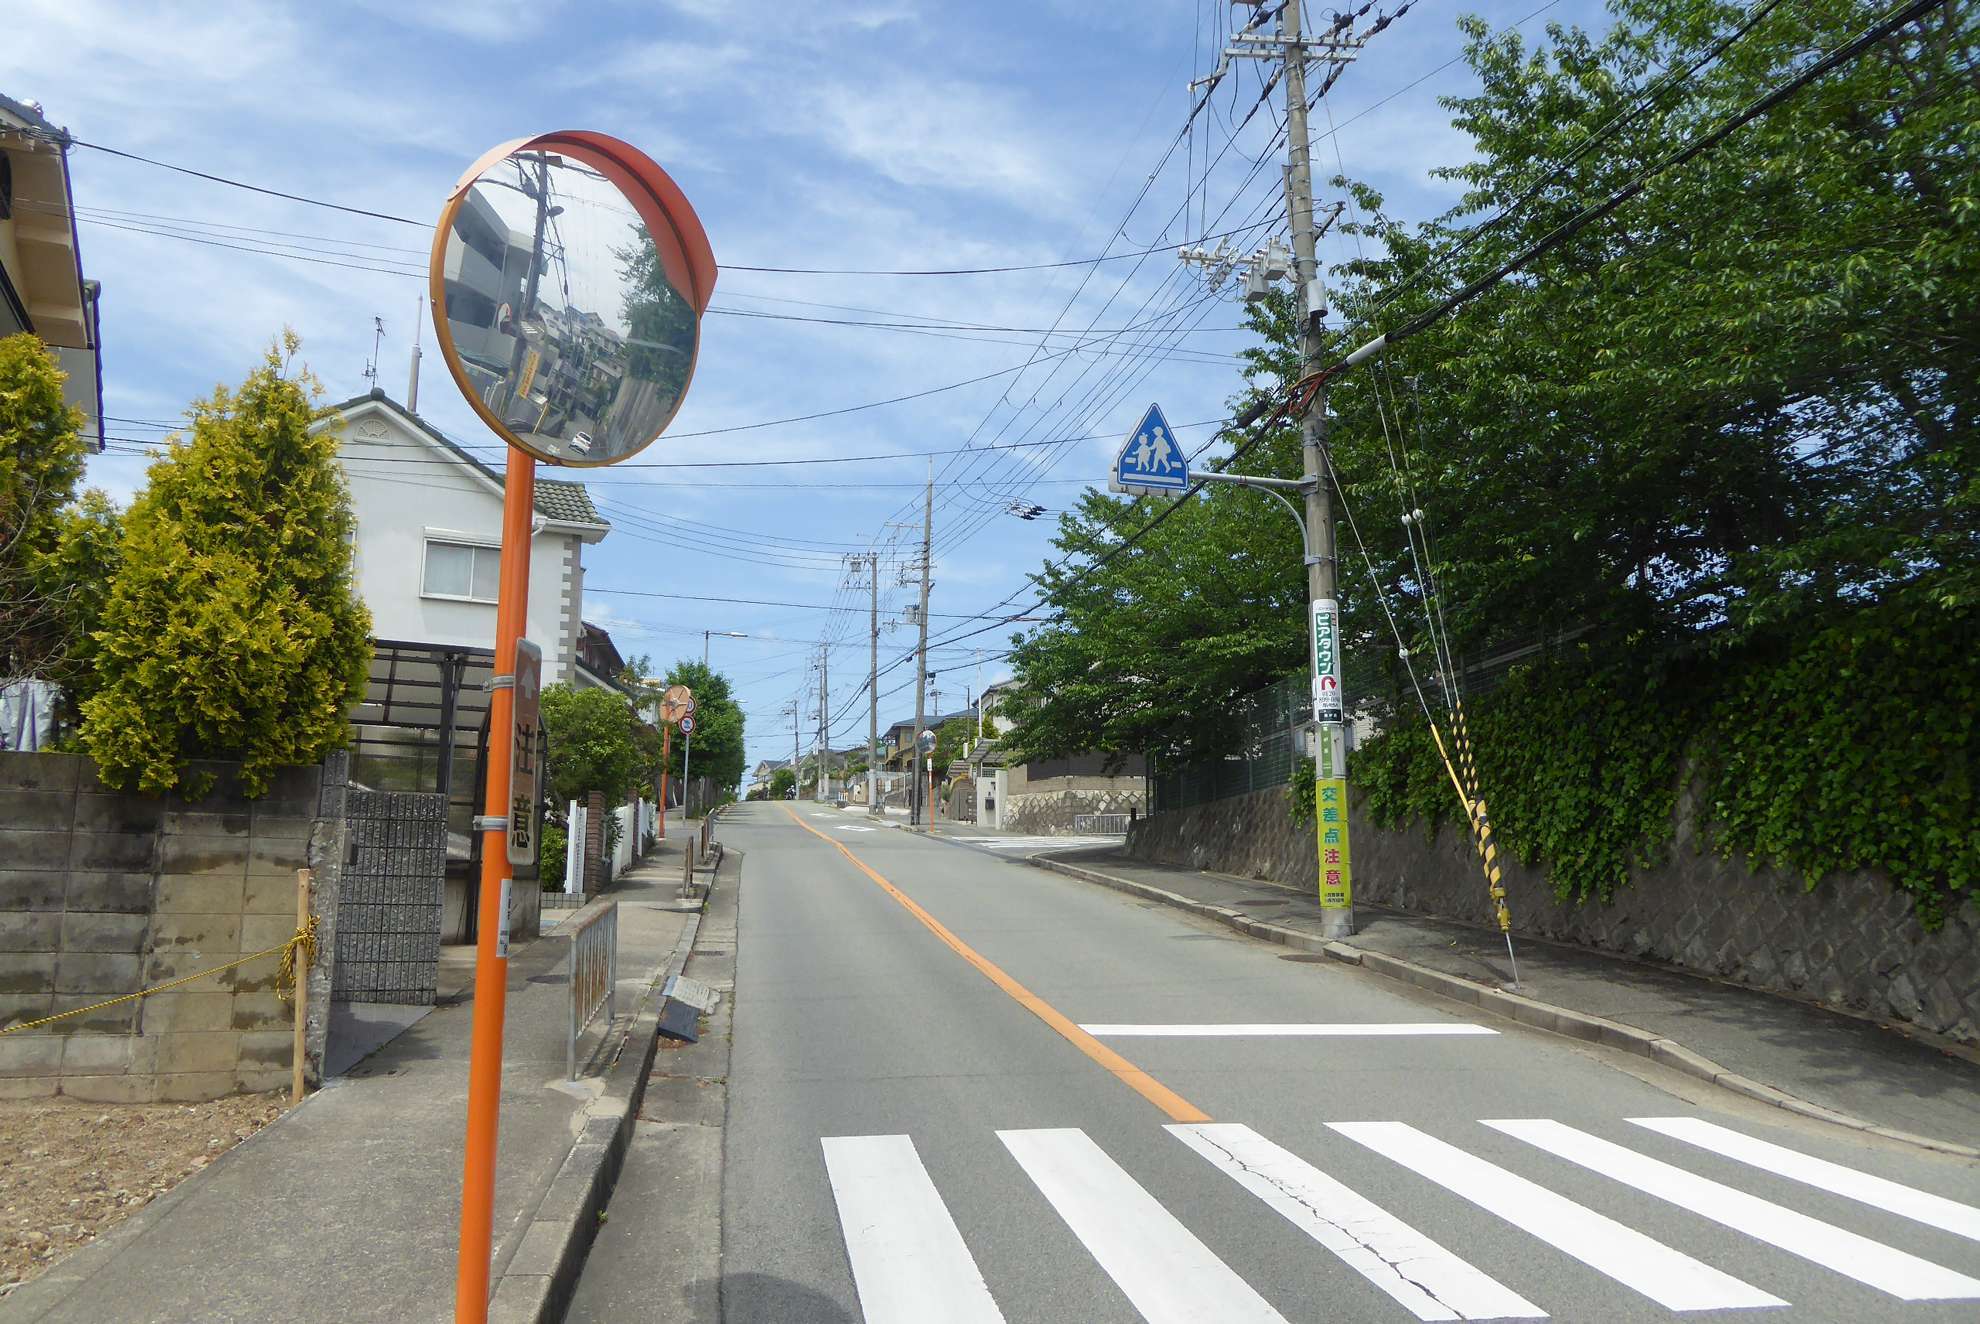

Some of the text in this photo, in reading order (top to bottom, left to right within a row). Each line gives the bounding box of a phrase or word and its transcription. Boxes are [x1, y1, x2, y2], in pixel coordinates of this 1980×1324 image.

[1317, 613, 1332, 674] ピアタウン
[512, 722, 534, 848] 注意
[1322, 787, 1341, 885] 交差点注意
